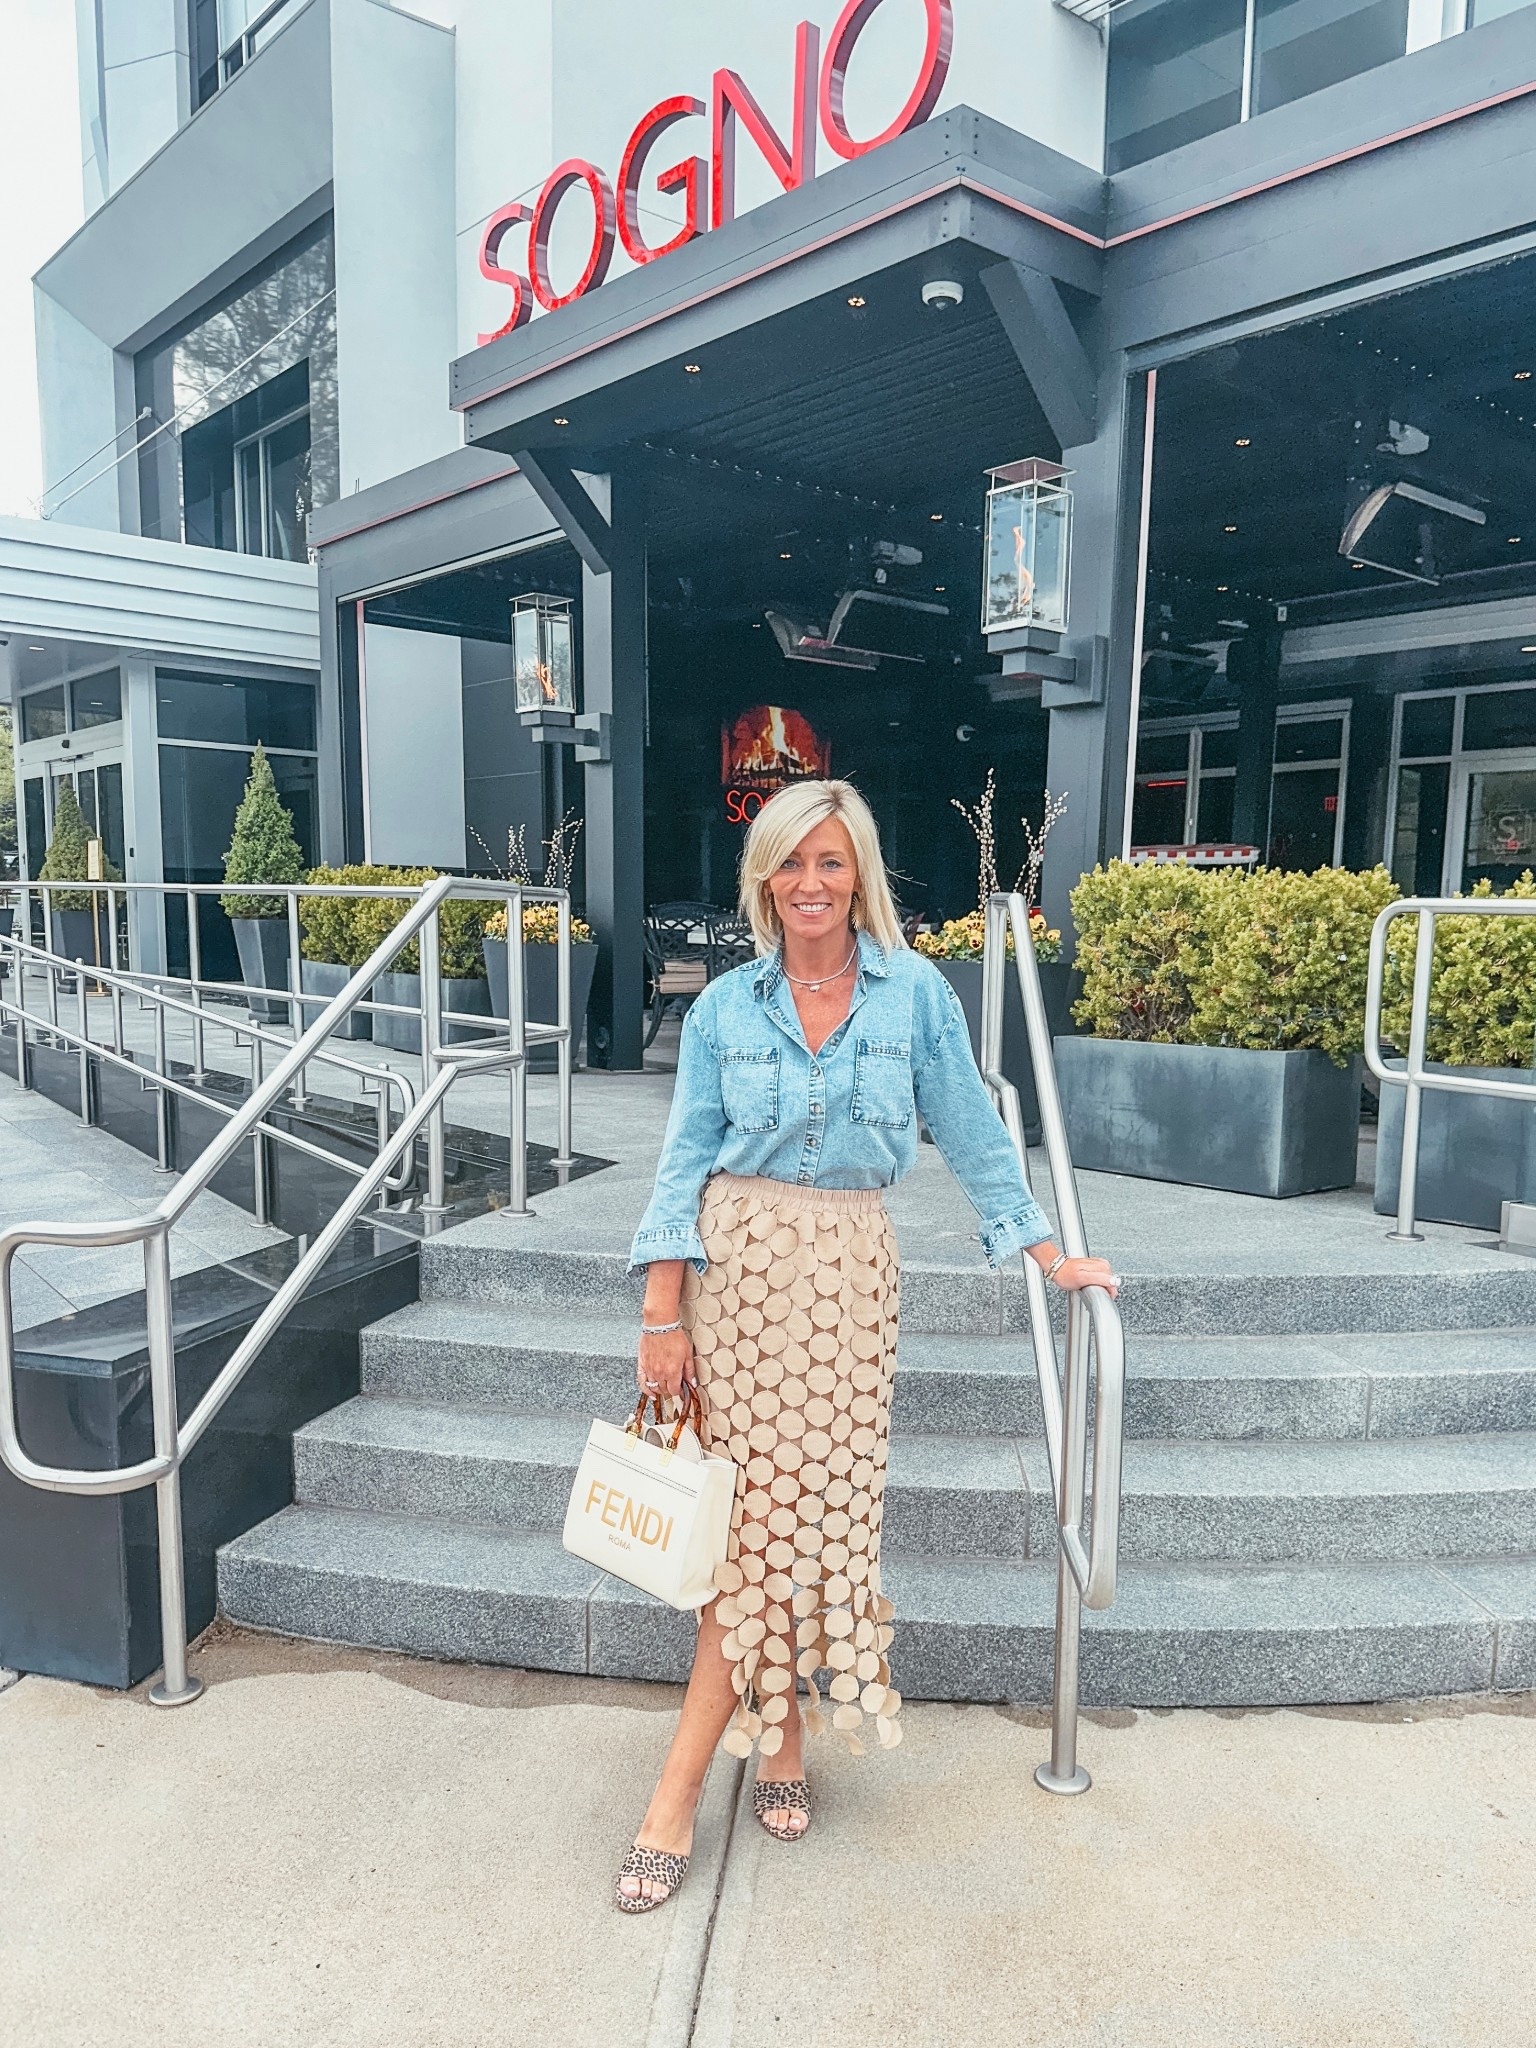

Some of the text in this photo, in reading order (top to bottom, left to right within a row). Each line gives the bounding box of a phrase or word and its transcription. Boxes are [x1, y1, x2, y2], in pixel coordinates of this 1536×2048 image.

[477, 0, 953, 346] SOGNO
[726, 790, 776, 824] SO
[584, 1479, 675, 1552] FENDI
[608, 1534, 631, 1552] ROMA
